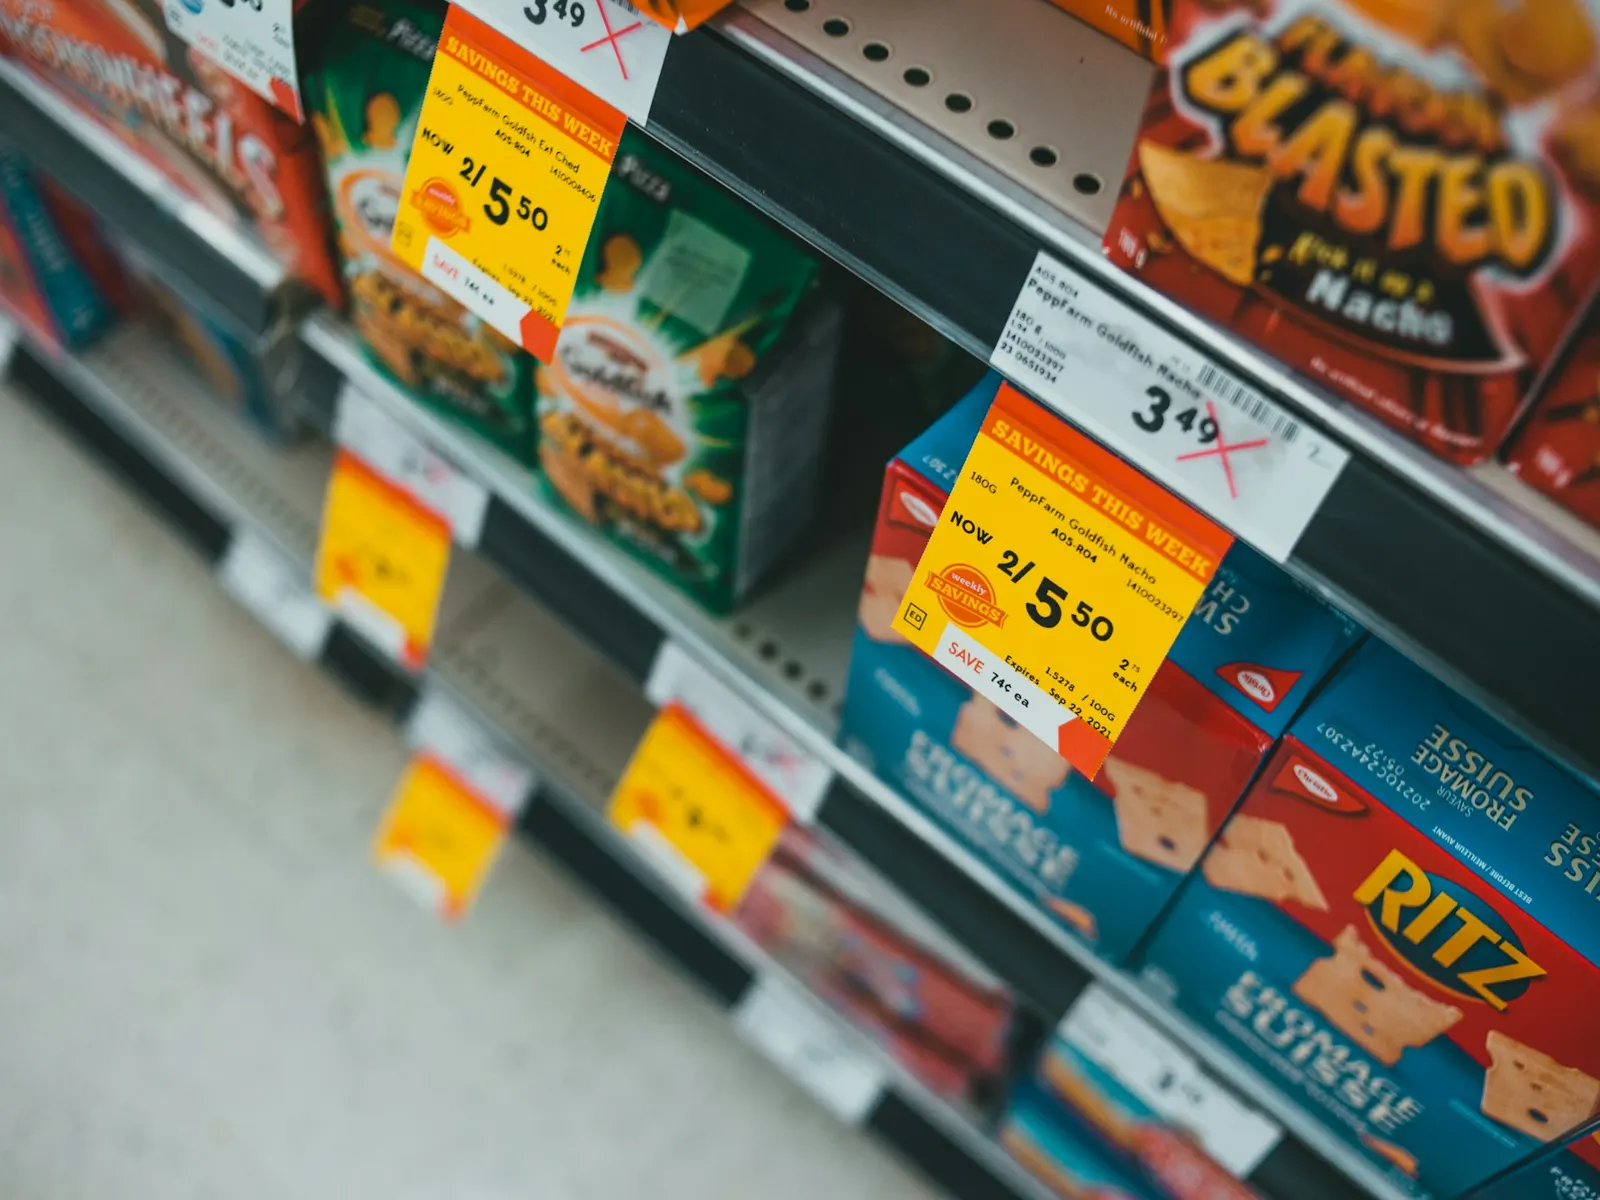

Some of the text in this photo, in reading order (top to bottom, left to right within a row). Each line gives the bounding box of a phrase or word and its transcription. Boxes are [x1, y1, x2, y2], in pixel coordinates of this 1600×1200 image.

[552, 0, 586, 28] 49
[446, 36, 613, 157] SAVINGS THIS WEEK
[422, 127, 454, 156] NOW
[502, 115, 536, 144] Goldfish
[555, 151, 581, 173] Ched
[1186, 31, 1548, 269] BLASTED
[1305, 268, 1453, 346] Nacho
[1027, 278, 1093, 328] PeppFarm
[1096, 323, 1153, 368] Goldfish
[1156, 362, 1201, 399] Nacho
[1131, 385, 1219, 444] 3 49
[970, 471, 998, 495] 180G
[990, 419, 1211, 578] SAVINGS THIS WEEK
[950, 510, 993, 546] NOW
[1010, 477, 1157, 585] PeppFarm Goldfish Nacho
[931, 577, 1001, 623] SAVINGS
[951, 571, 987, 596] weekly
[1126, 578, 1184, 624] 1410023297
[908, 608, 923, 624] ED
[948, 641, 985, 675] SAVE
[1119, 658, 1130, 672] 2
[990, 671, 1031, 708] 74¢ ea
[1004, 655, 1040, 687] Expires
[1048, 687, 1067, 707] Sep
[1086, 716, 1113, 739] 2021
[1045, 666, 1076, 693] 1.5278
[1089, 699, 1116, 723] 100G
[1112, 671, 1138, 693] each
[1410, 744, 1518, 832] FROMAGE
[1424, 723, 1535, 812] SUISSE
[1436, 785, 1474, 818] SAVEUR
[1432, 825, 1456, 846] AVANT
[1454, 842, 1487, 870] MEILLEUR
[1490, 869, 1514, 891] BEFORE
[1544, 841, 1600, 903] ISS
[1513, 887, 1533, 905] BEST
[1353, 847, 1547, 1013] RITZ
